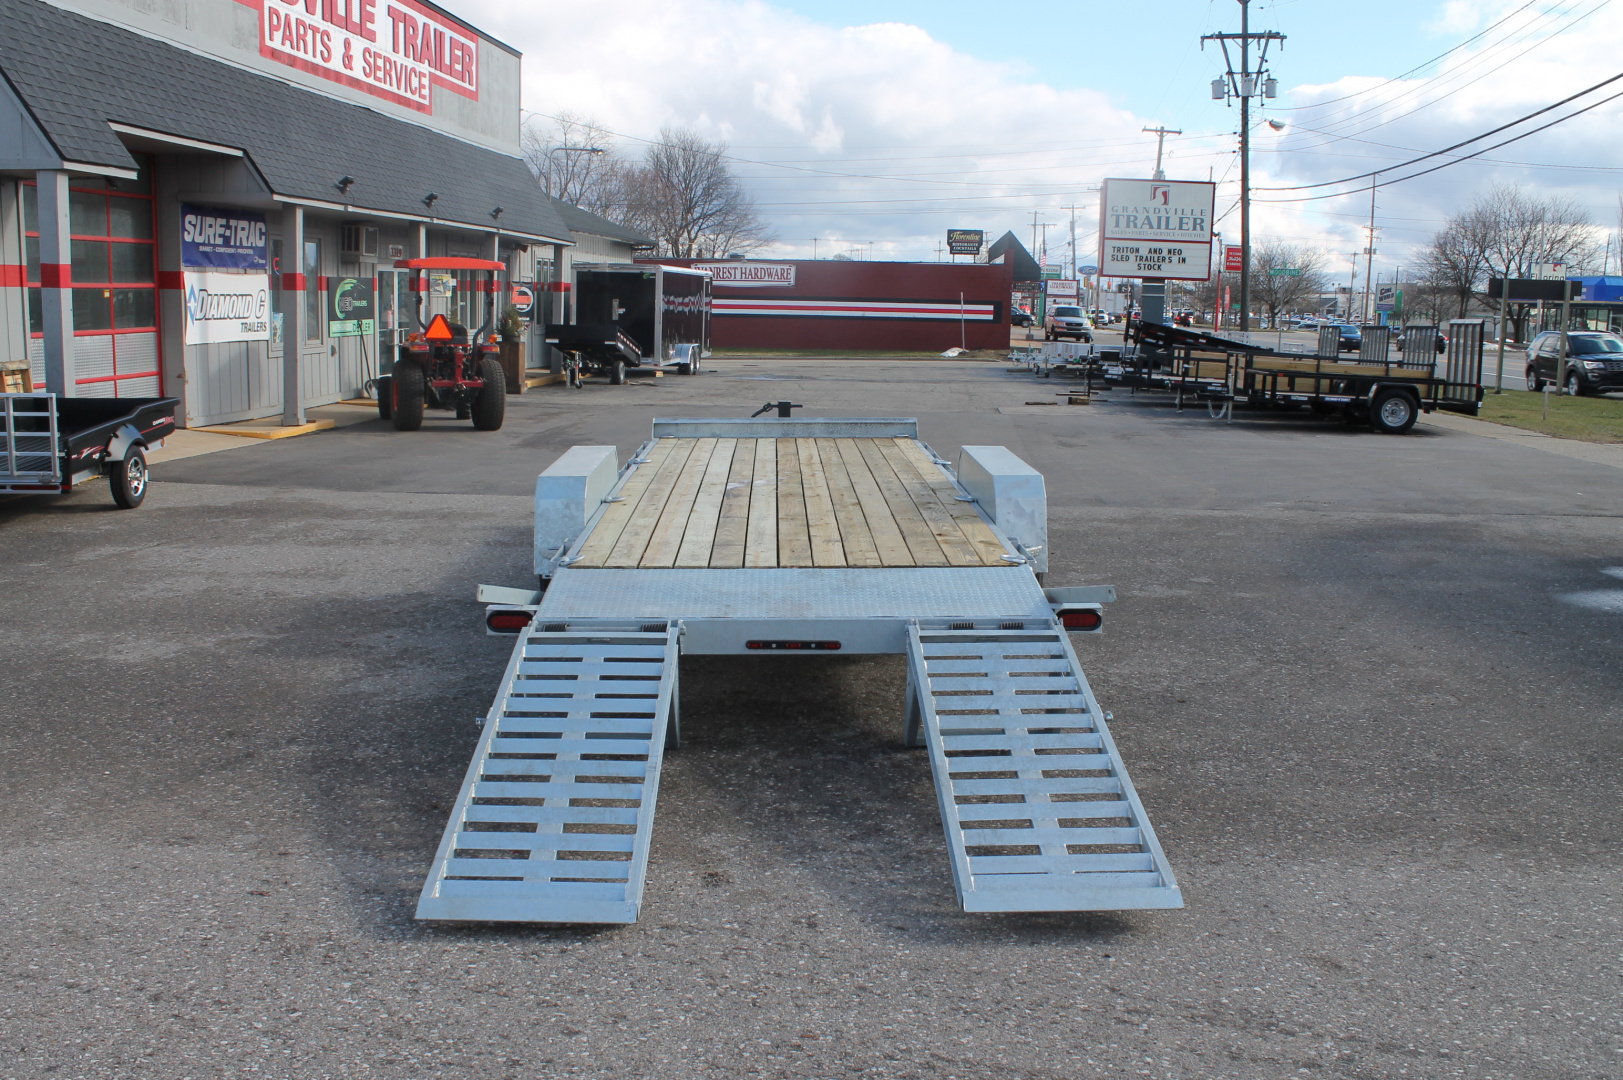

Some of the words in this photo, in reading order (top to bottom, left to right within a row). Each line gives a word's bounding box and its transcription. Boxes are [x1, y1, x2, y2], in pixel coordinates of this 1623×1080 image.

[388, 5, 475, 87] TRAILER
[268, 6, 332, 63] PARTS
[342, 37, 354, 71] &
[362, 47, 428, 100] SERVICE
[1111, 205, 1207, 217] GRANDVILLE
[1111, 214, 1206, 232] TRAILER
[184, 214, 266, 248] SURE-TRAC
[1112, 246, 1140, 255] TRITON
[1148, 247, 1163, 256] AND
[1167, 248, 1183, 256] NEO
[1111, 254, 1130, 262] SLED
[1134, 255, 1173, 264] TRAILERS
[740, 266, 792, 281] HARDWARE
[1137, 263, 1162, 271] STOCK
[1531, 272, 1565, 281] Floring
[195, 289, 254, 321] DIAMOND
[255, 289, 267, 319] C
[240, 321, 267, 334] TRAILERS
[352, 322, 371, 333] DELER
